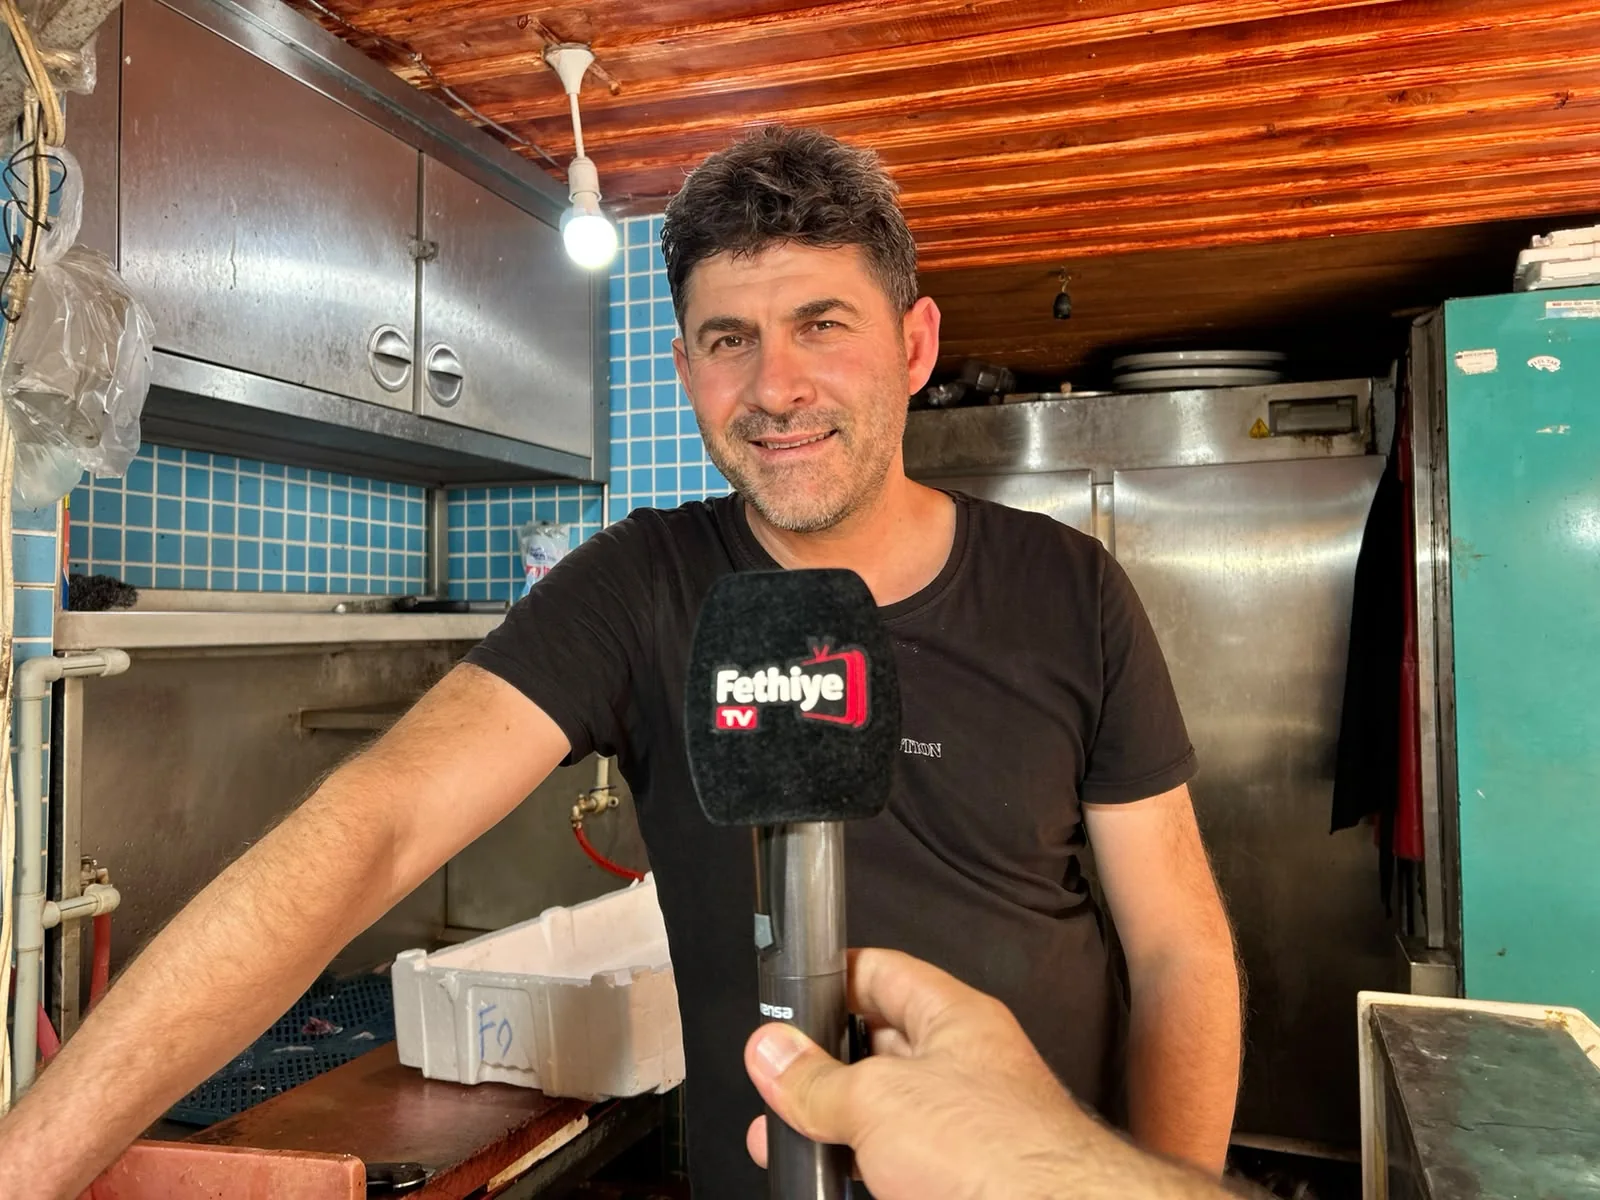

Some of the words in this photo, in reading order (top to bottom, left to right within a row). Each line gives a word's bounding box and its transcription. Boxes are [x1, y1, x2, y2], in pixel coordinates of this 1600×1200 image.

[716, 666, 844, 712] Fethiye
[721, 709, 754, 727] TV
[900, 738, 942, 758] TION
